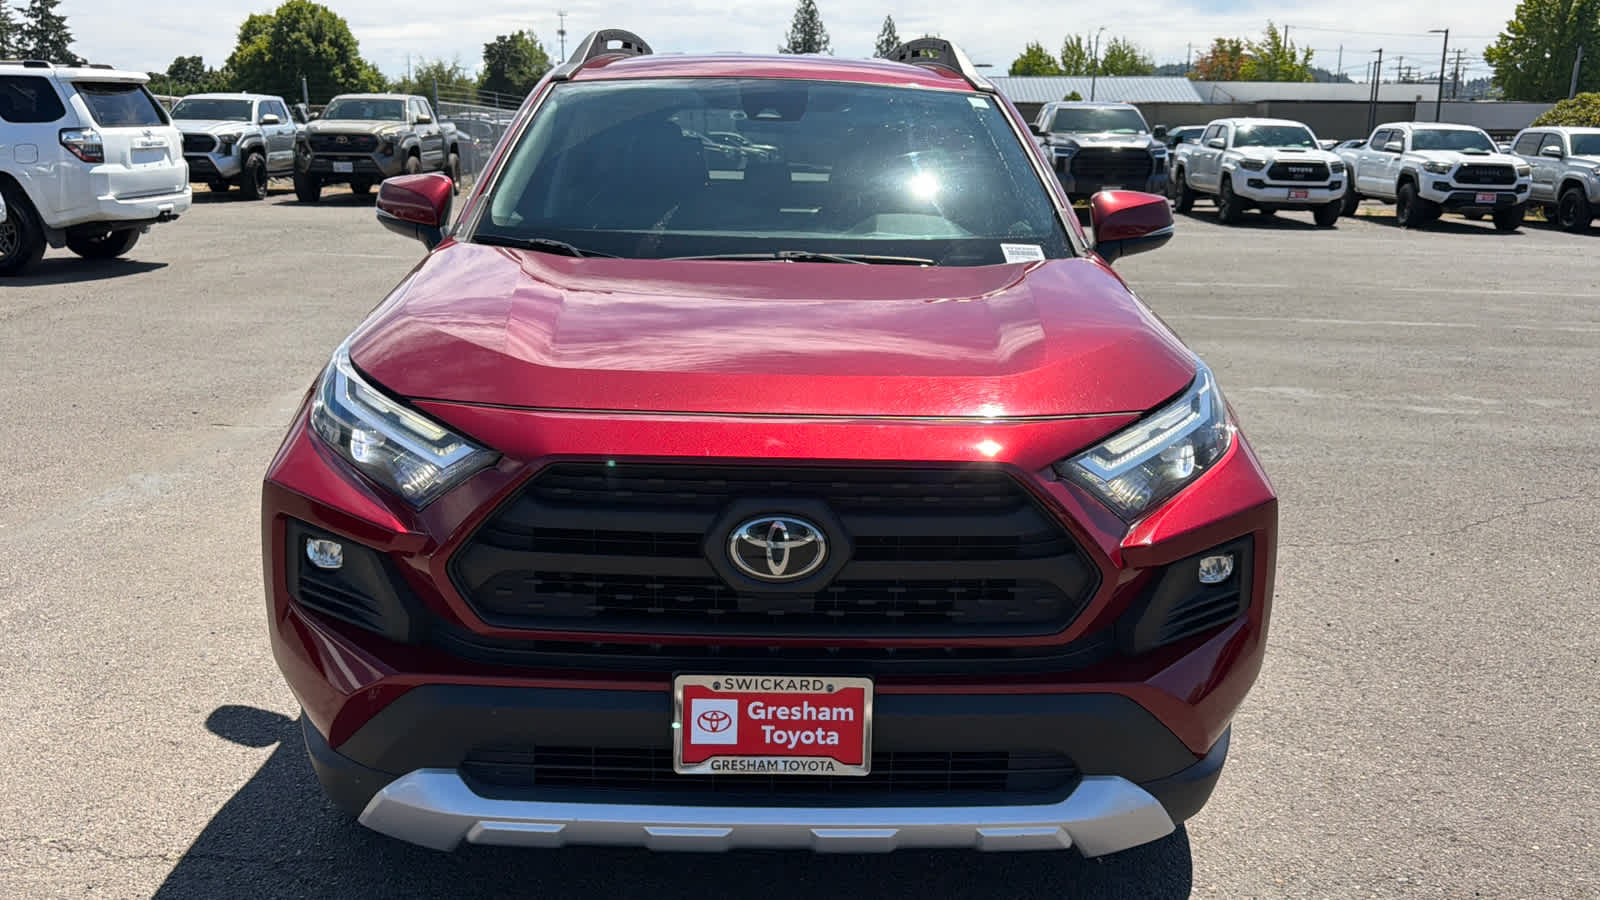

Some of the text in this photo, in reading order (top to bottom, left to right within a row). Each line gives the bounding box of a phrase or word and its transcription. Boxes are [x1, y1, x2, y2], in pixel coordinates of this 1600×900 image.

[724, 678, 824, 691] SWICKARD
[747, 701, 854, 721] Gresham
[761, 725, 839, 749] Toyota
[711, 759, 835, 772] GRESHAM TOYOTA
